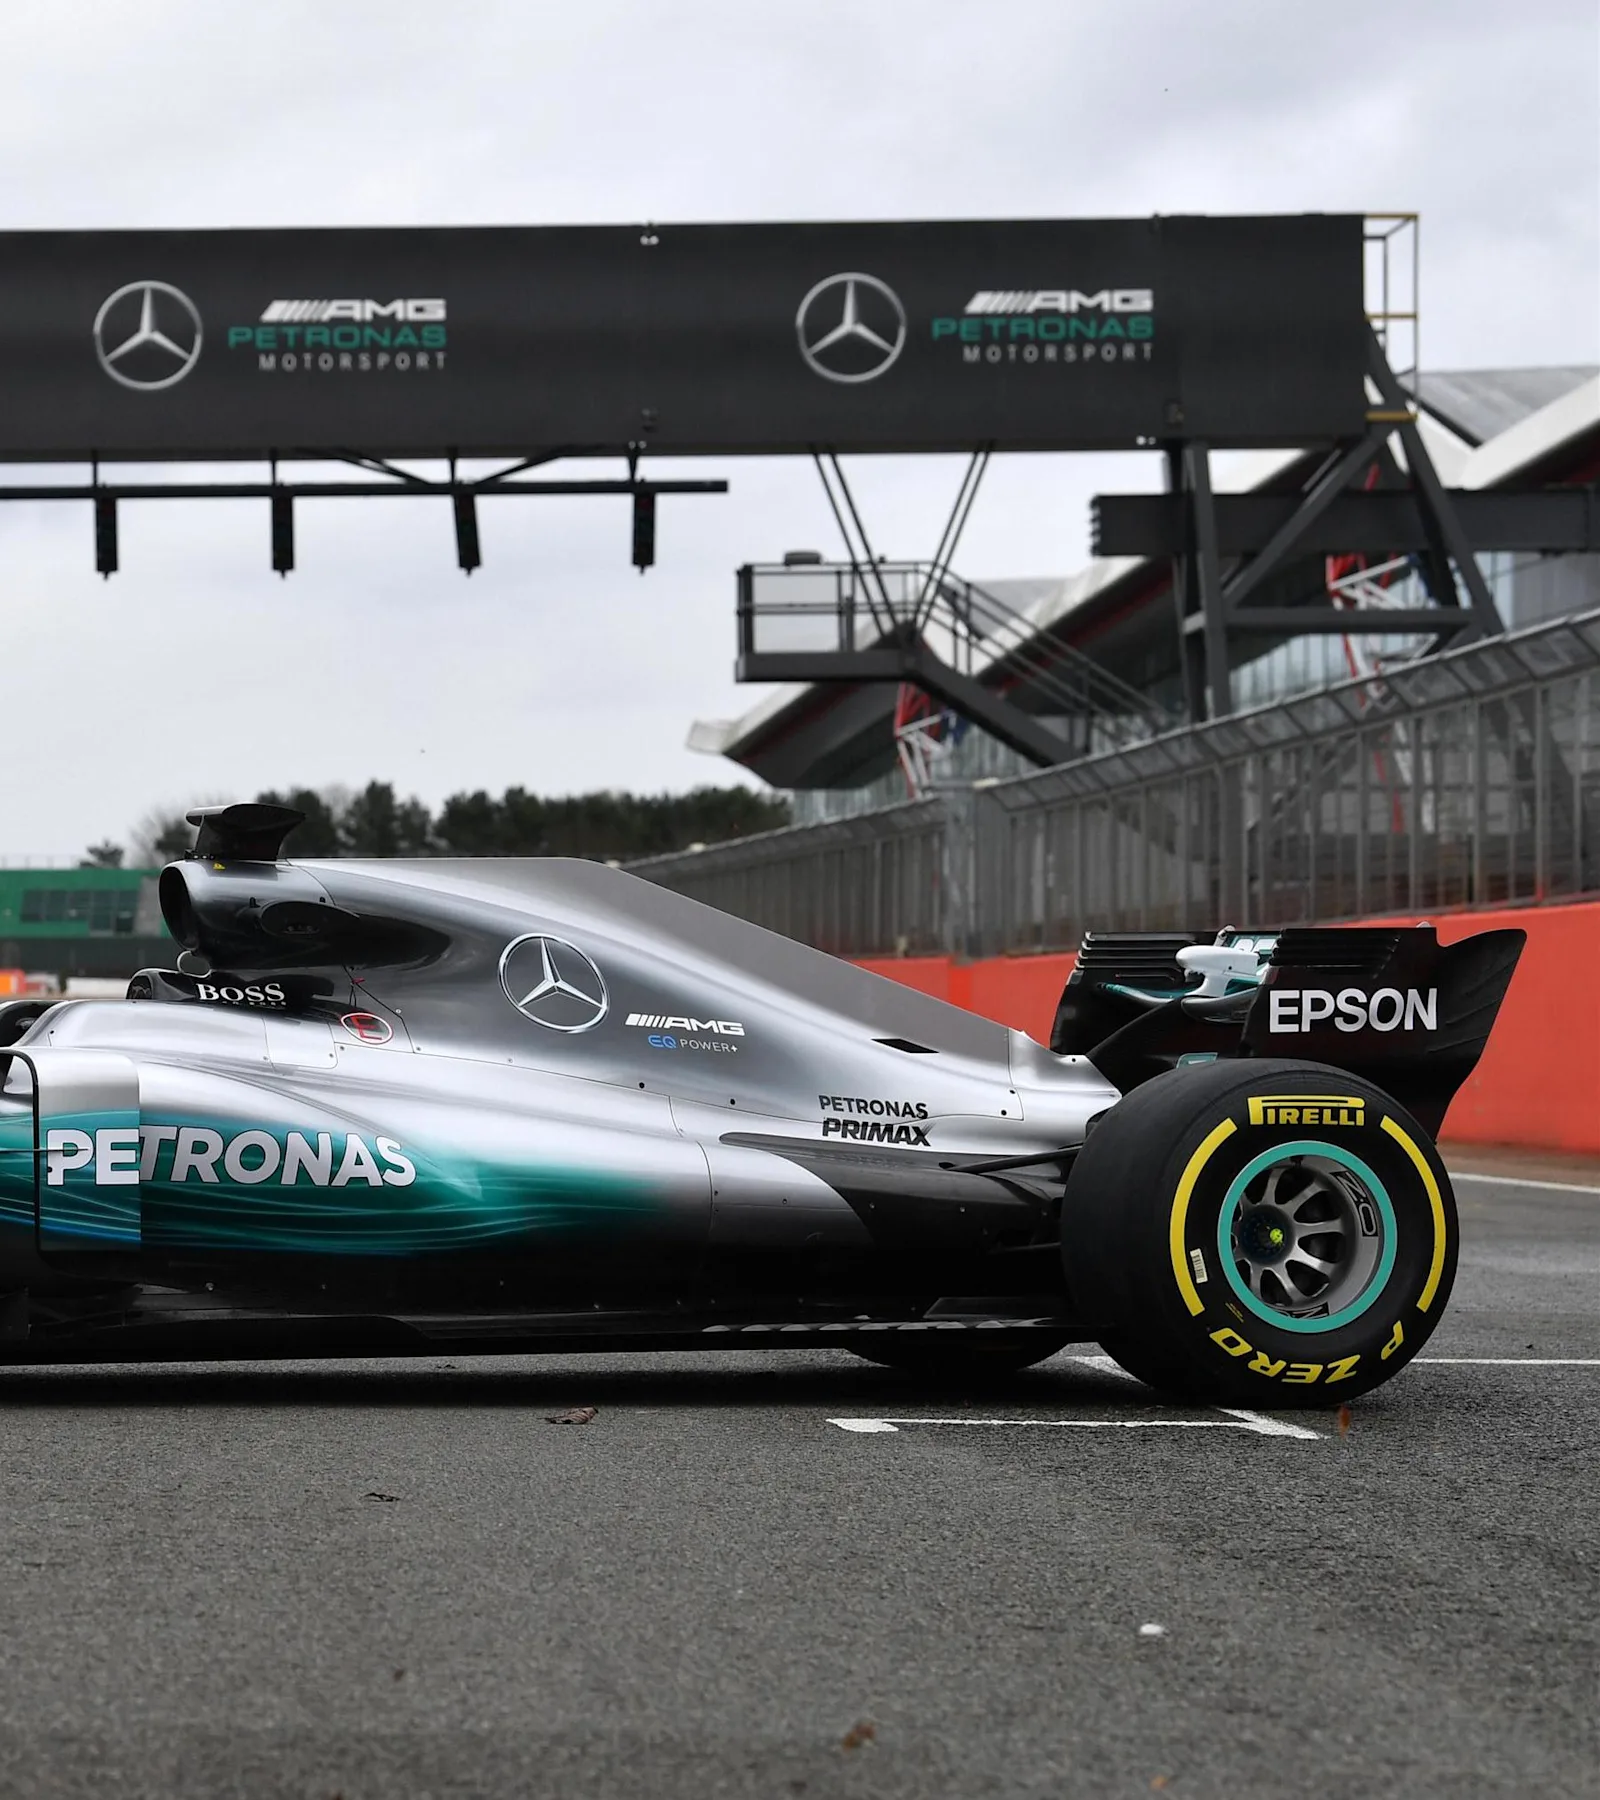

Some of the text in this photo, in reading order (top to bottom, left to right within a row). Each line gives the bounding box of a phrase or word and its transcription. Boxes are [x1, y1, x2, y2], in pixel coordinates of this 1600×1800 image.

[325, 299, 447, 321] AMG
[1028, 290, 1153, 312] AMG
[228, 325, 447, 347] PETRONAS
[931, 316, 1154, 341] PETRONAS
[258, 352, 447, 371] MOTORSPORT
[962, 343, 1152, 363] MOTORSPORT
[195, 983, 285, 1001] BOSS
[1269, 987, 1437, 1033] EPSON
[663, 1016, 745, 1036] AMG
[647, 1034, 677, 1049] EQ
[818, 1094, 929, 1119] PETRONAS
[1247, 1095, 1365, 1126] PIRELLI
[822, 1117, 936, 1147] PRIMAX
[47, 1125, 418, 1187] PETRONAS
[1209, 1320, 1405, 1384] P ZERO
